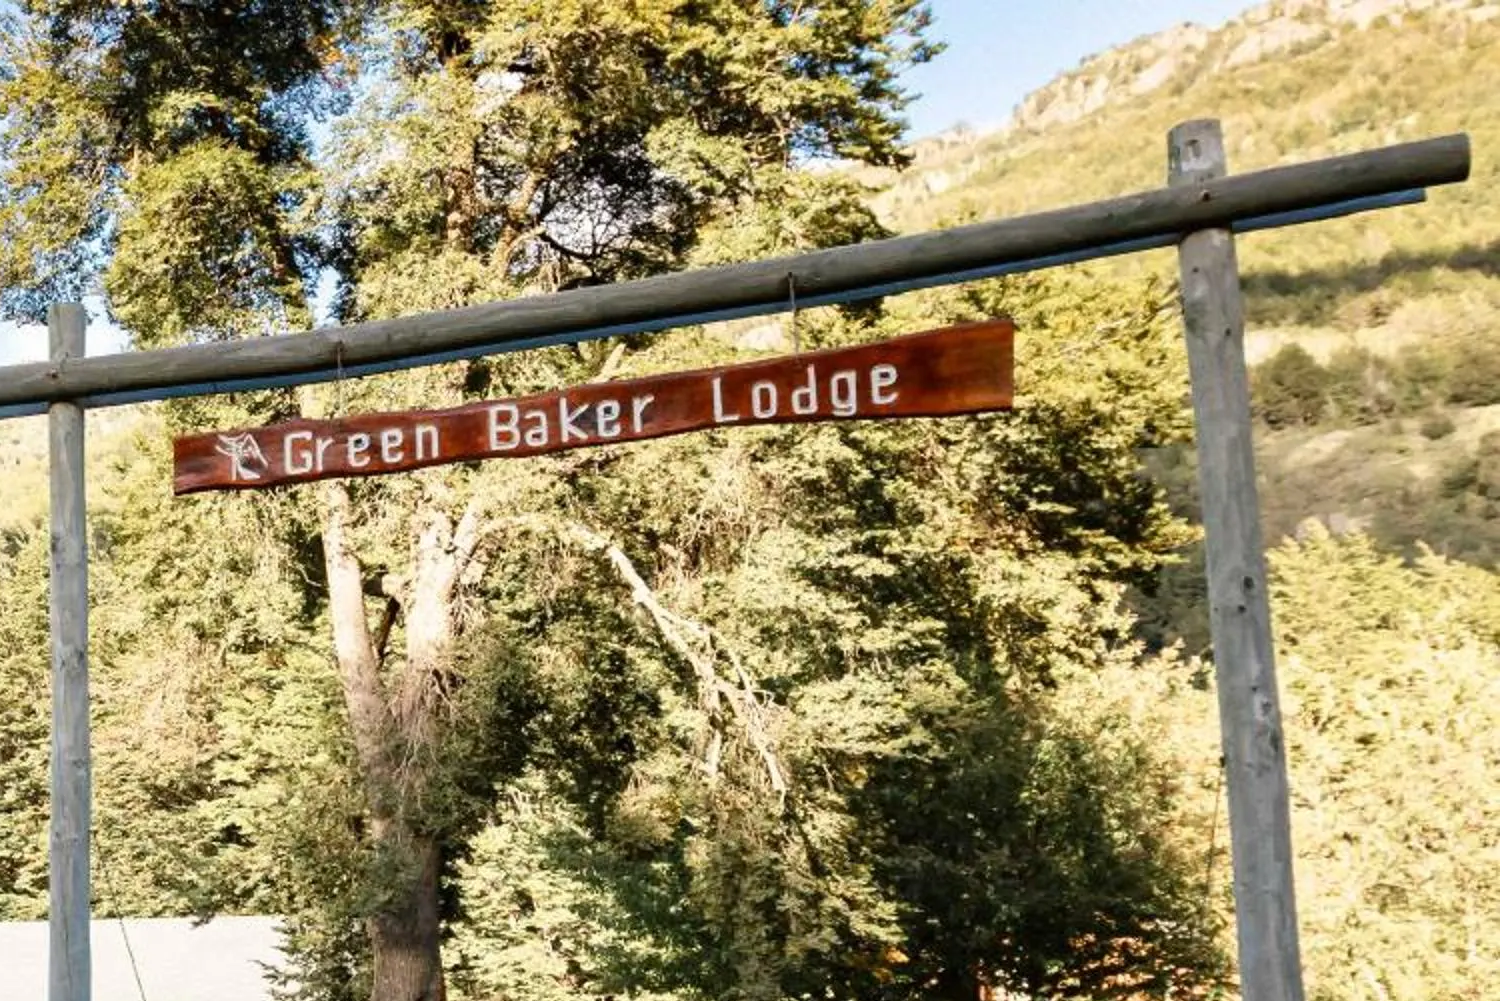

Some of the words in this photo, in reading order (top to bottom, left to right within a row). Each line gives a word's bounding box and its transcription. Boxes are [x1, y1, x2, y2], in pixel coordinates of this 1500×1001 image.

[282, 422, 441, 476] Green
[488, 394, 655, 452] Baker
[711, 362, 900, 424] Lodge
